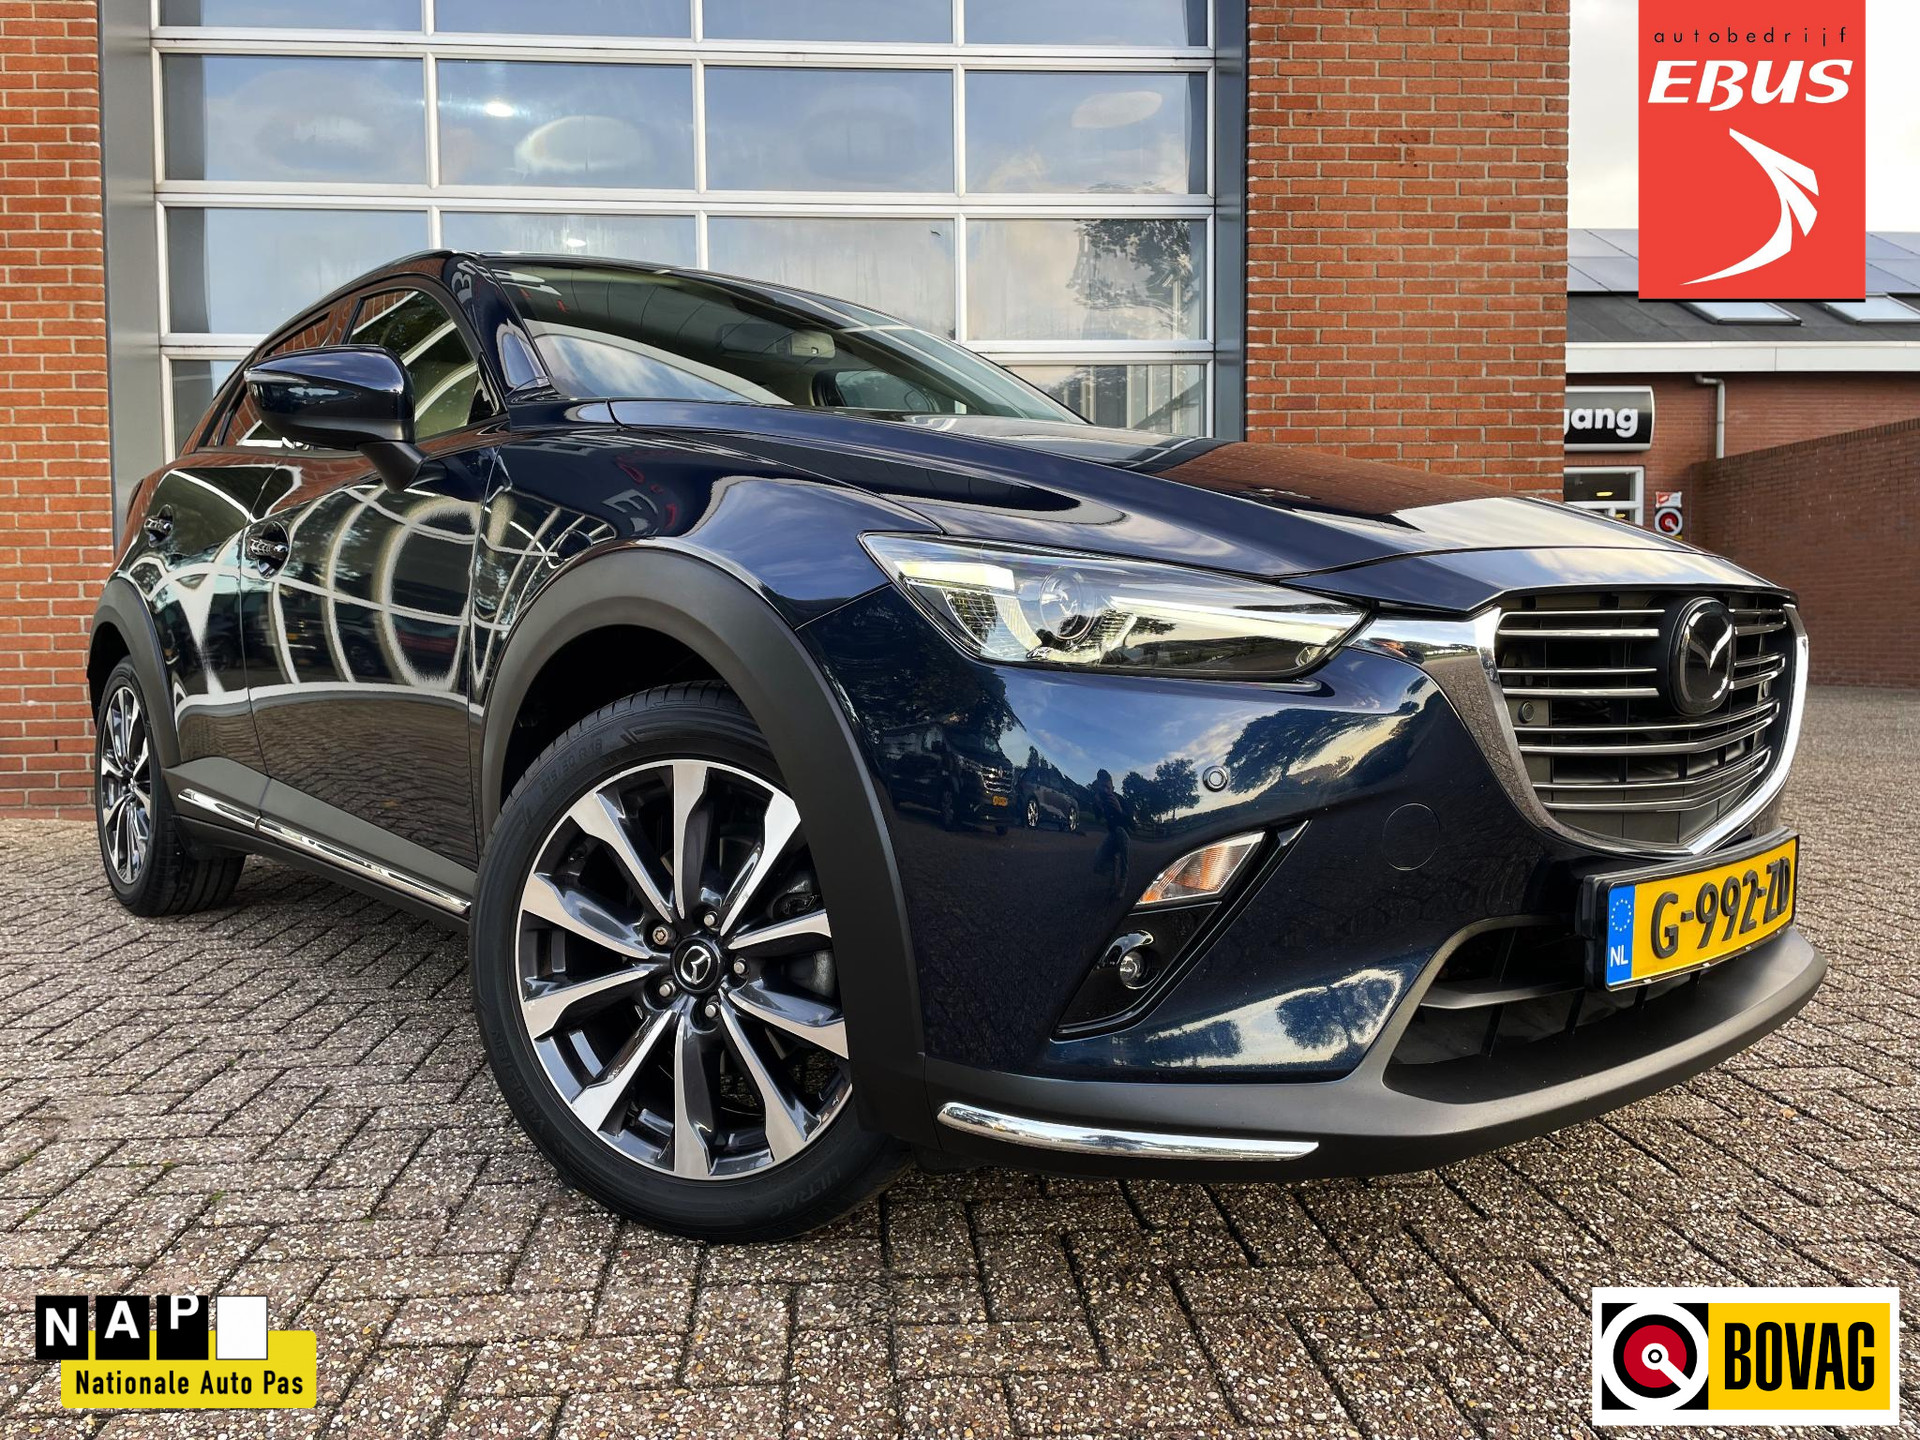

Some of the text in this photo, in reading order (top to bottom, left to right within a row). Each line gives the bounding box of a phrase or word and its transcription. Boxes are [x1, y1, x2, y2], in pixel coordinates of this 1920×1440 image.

[1650, 857, 1791, 959] G-992-ZD
[1609, 945, 1629, 968] NL
[766, 1164, 842, 1219] ULTRAC
